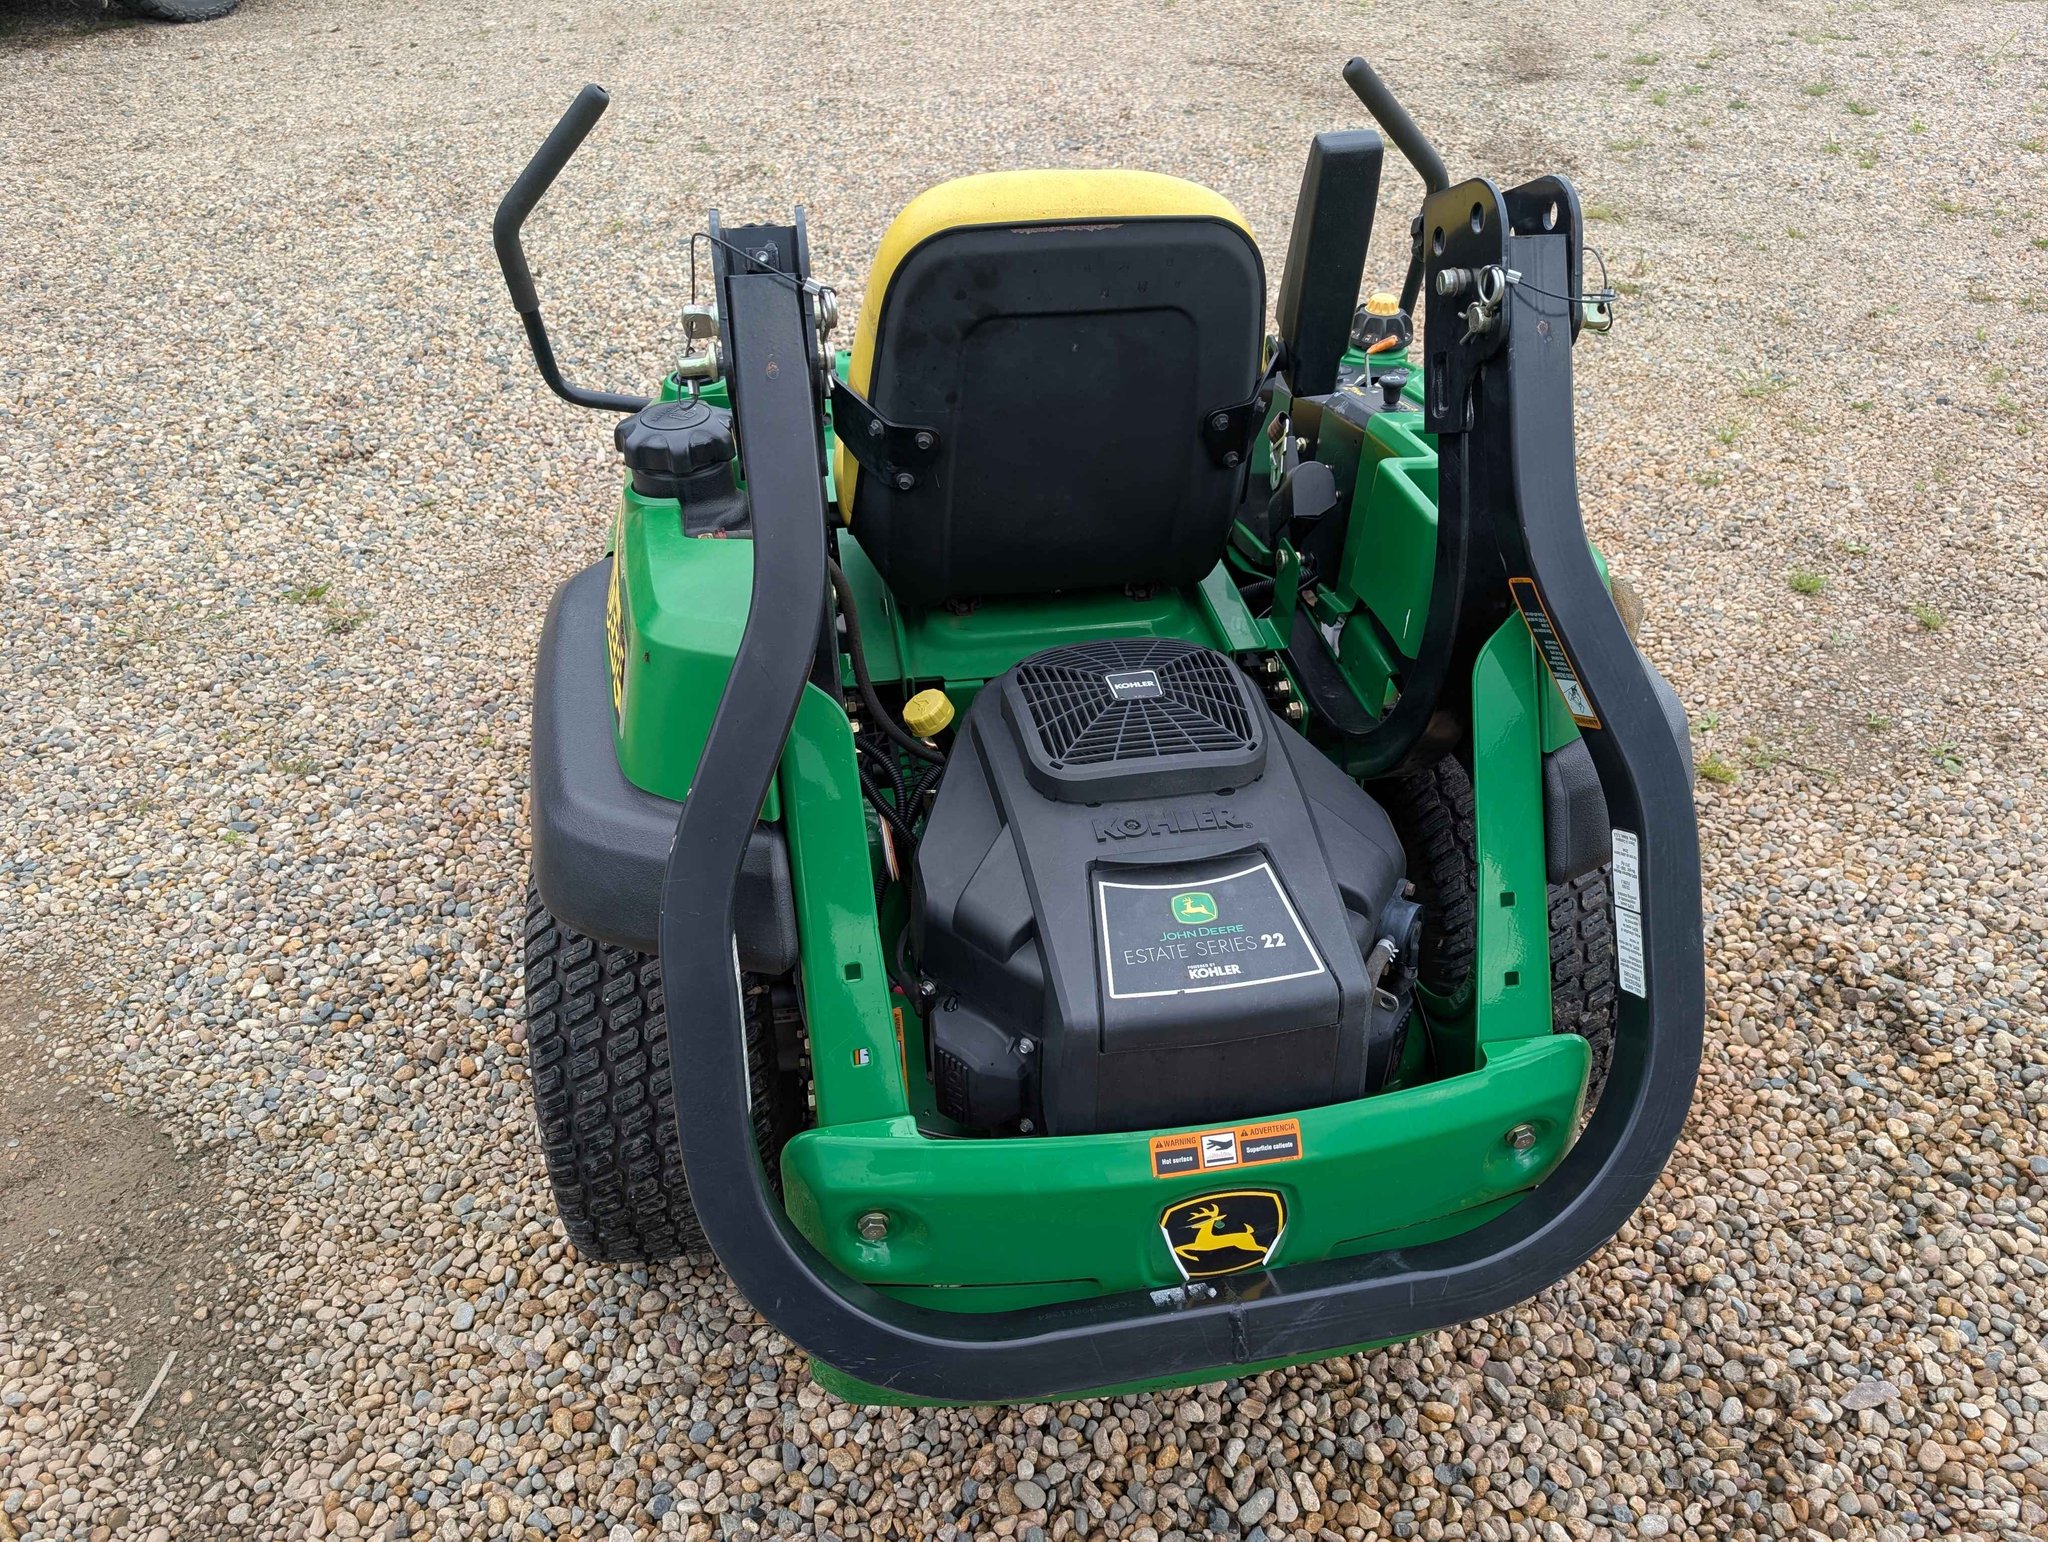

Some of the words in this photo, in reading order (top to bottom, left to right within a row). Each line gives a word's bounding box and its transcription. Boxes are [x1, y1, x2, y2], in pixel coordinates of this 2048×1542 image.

[1114, 680, 1155, 690] KOHLER
[1159, 929, 1197, 942] JOHN
[1198, 924, 1246, 938] DEERE
[1123, 943, 1190, 966] ESTATE
[1195, 935, 1259, 957] SERIES
[1260, 932, 1287, 949] 22
[1188, 964, 1242, 980] KOHLER
[1250, 1122, 1296, 1136] ADVERTENCIA
[1163, 1136, 1197, 1148] WARNING
[1246, 1143, 1273, 1154] Superficie
[1272, 1141, 1294, 1150] caliente
[1161, 1158, 1172, 1166] Hot
[1172, 1155, 1194, 1164] surface
